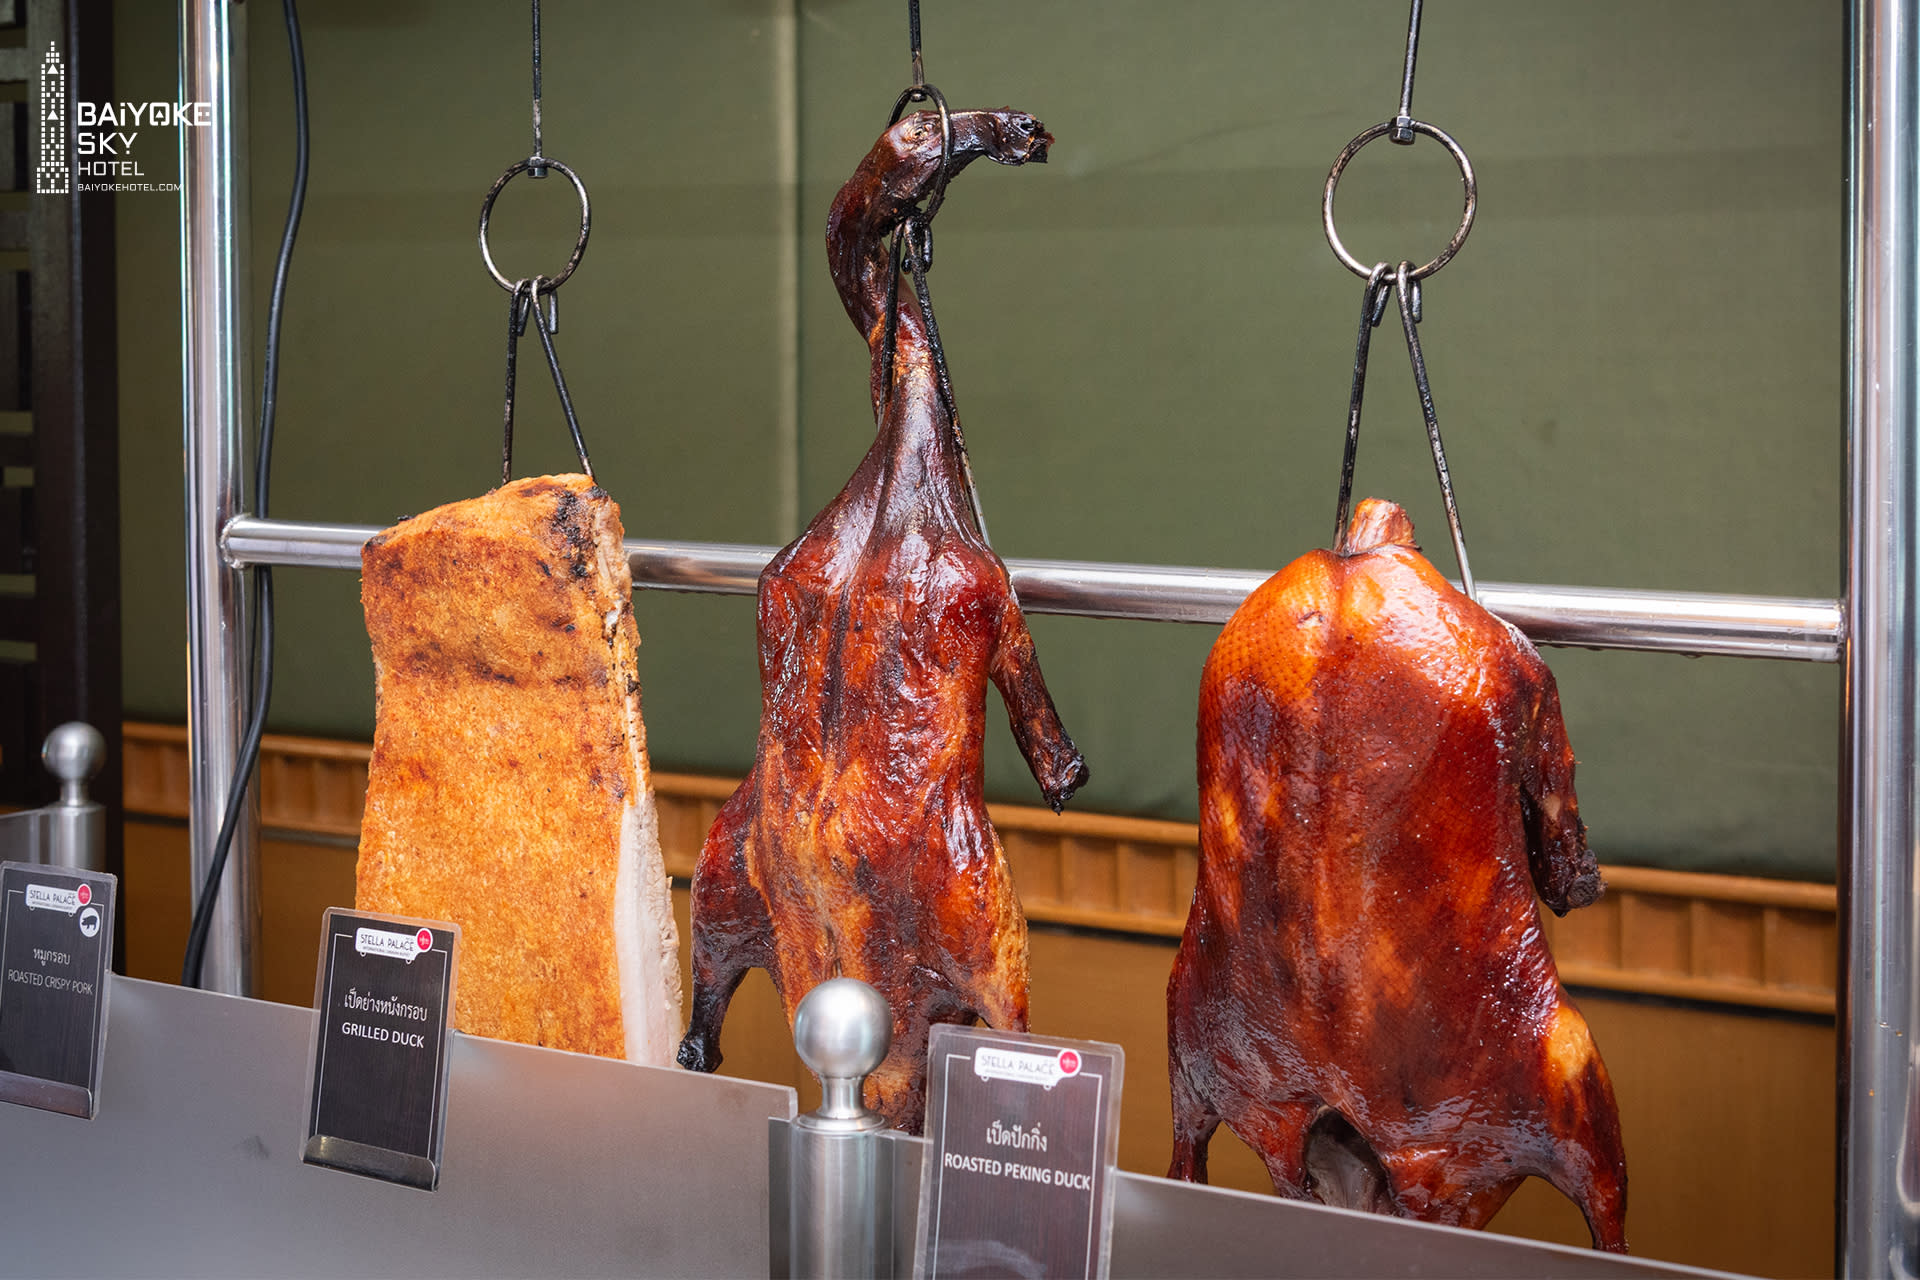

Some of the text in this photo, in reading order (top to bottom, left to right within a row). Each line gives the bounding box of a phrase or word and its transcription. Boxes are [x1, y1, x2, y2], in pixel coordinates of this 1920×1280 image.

[29, 889, 50, 902] STELLA
[52, 893, 76, 906] PALACE
[360, 934, 384, 947] STELLA
[387, 938, 414, 952] PALACE
[33, 948, 71, 966] หมูกรอบ
[8, 969, 93, 995] ROASTED CRISPY PORK
[344, 987, 428, 1022] เป็ดย่างหนังกรอบ
[341, 1021, 424, 1048] GRILLED DUCK
[981, 1055, 1014, 1069] STELLA
[1017, 1060, 1055, 1075] PALACE
[986, 1119, 1048, 1152] เป็ดปักกิ่ง
[944, 1152, 1091, 1191] ROASTED PEKING DUCK
